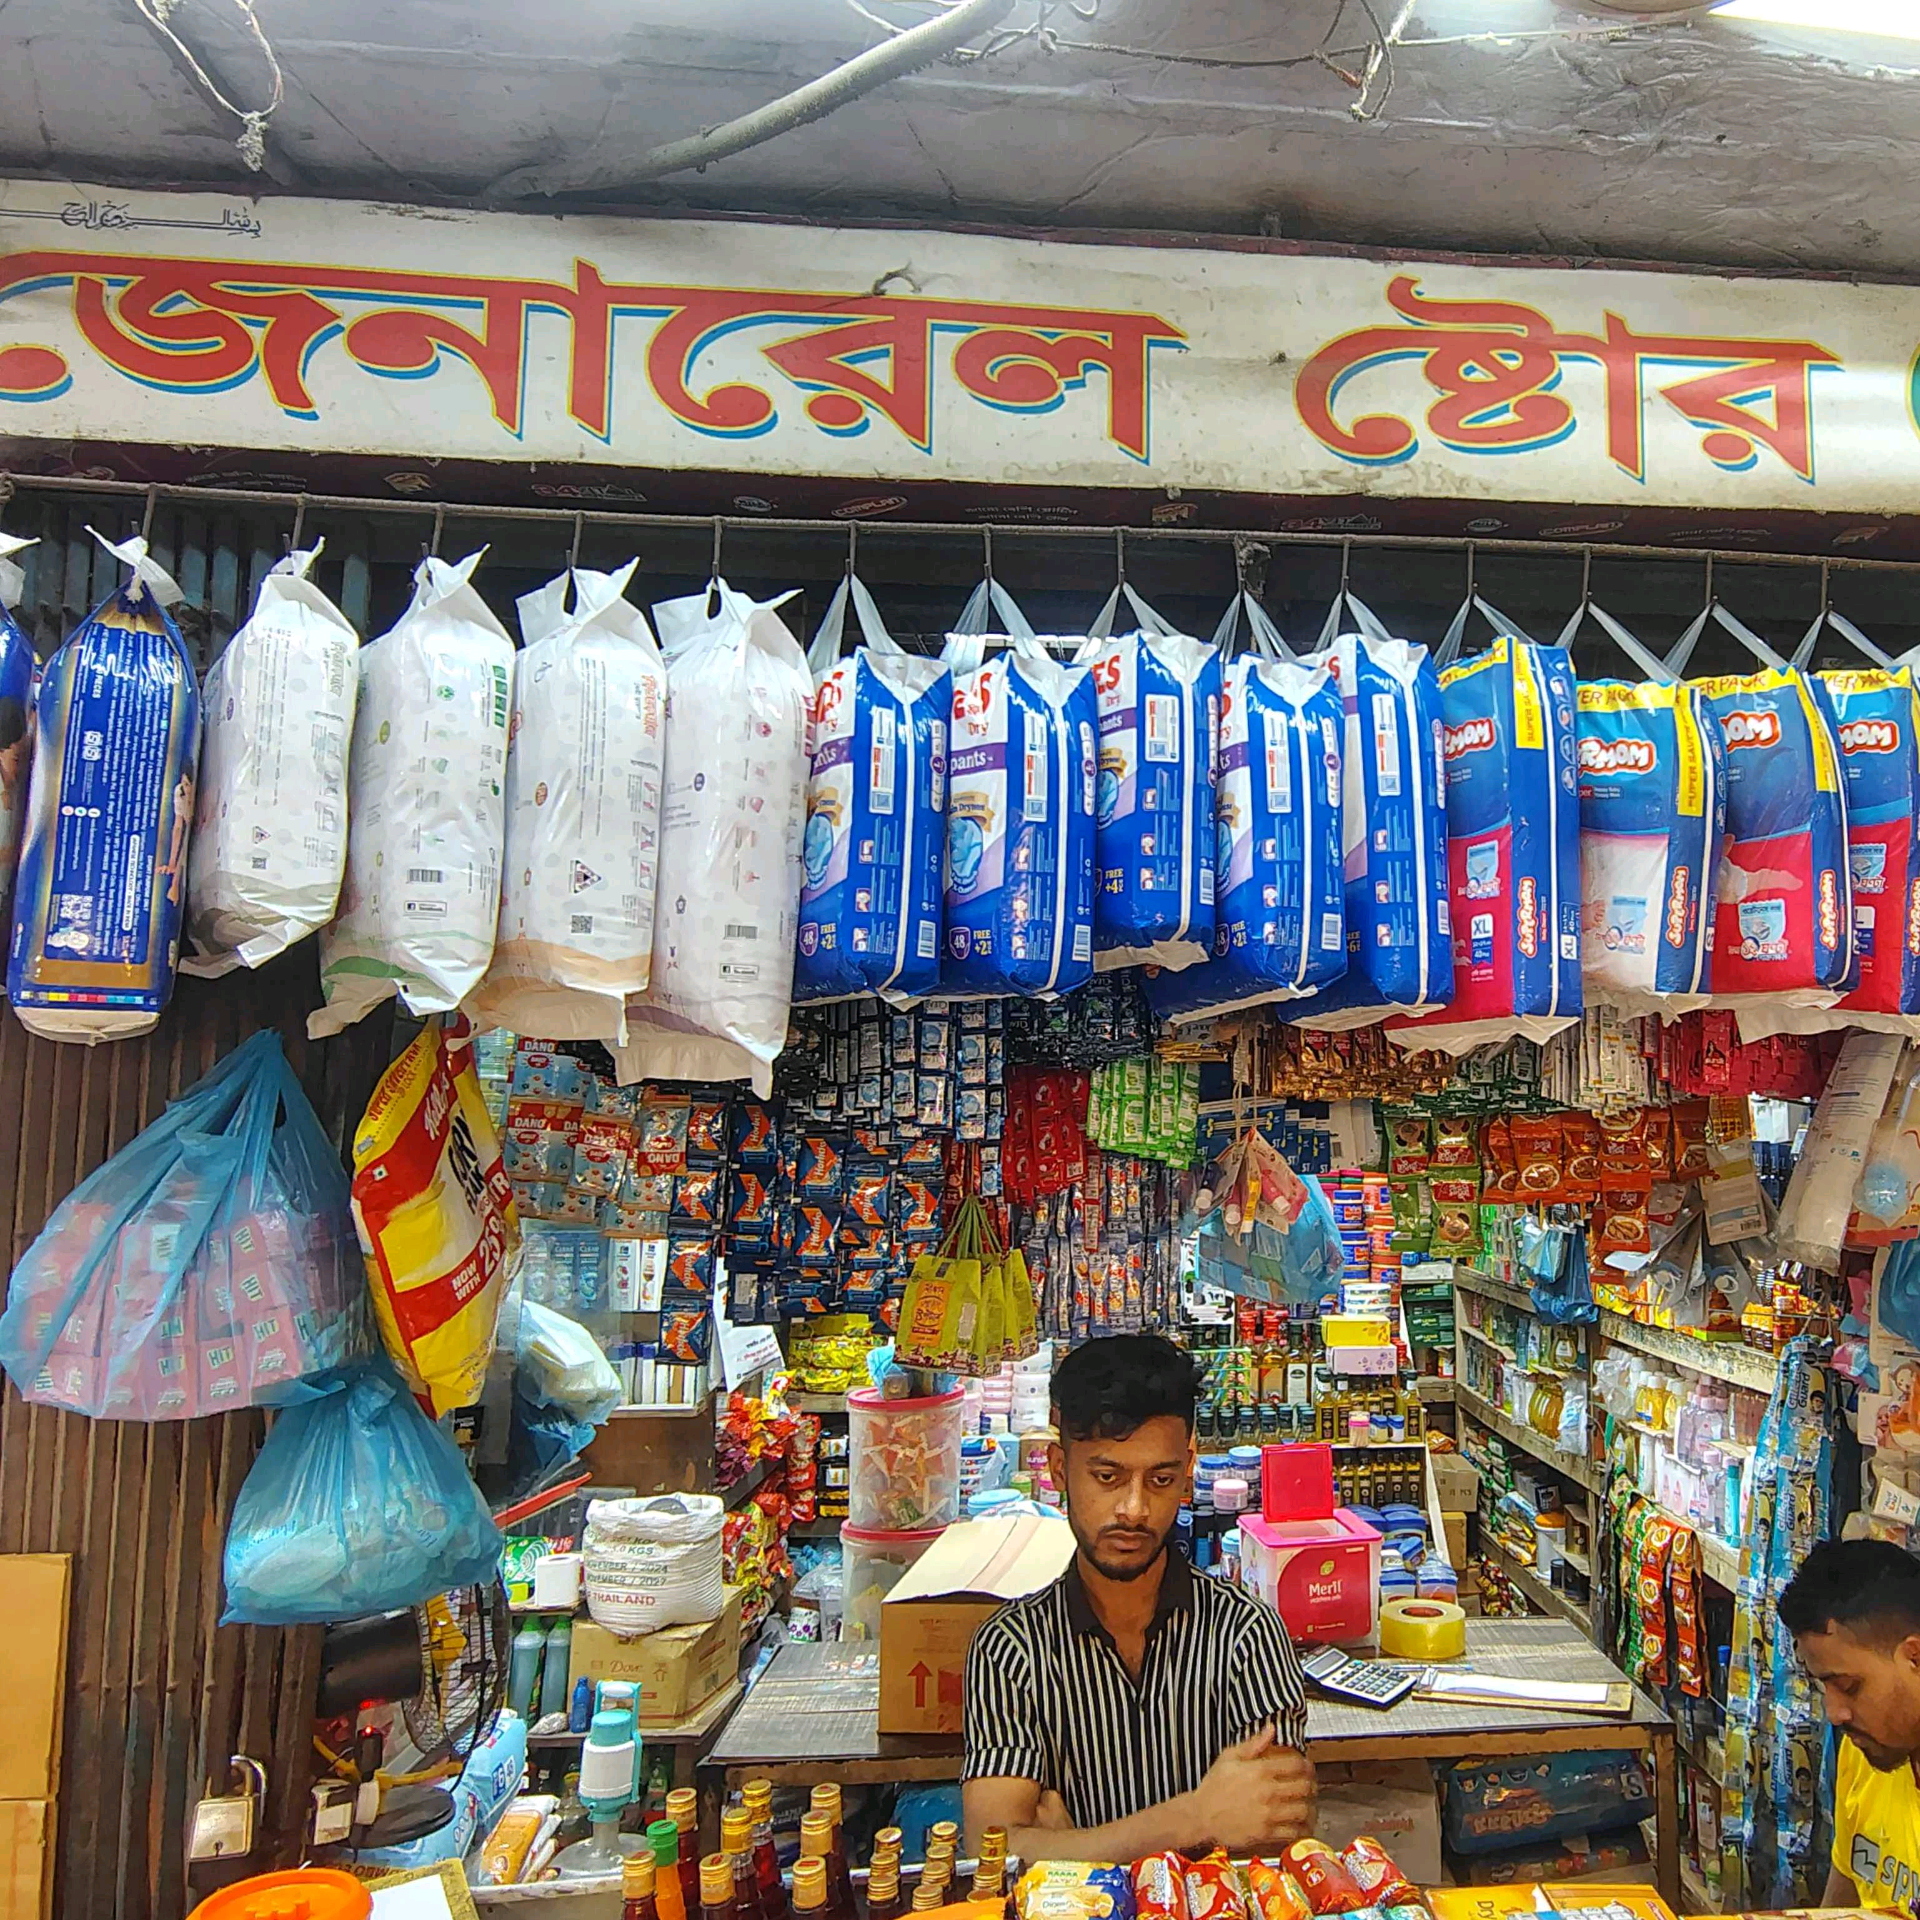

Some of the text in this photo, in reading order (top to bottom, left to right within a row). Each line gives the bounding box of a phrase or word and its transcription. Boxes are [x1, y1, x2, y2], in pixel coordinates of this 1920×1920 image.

[1292, 274, 1846, 487] ষ্টোর
[1104, 867, 1124, 879] FREE
[973, 929, 991, 939] FREE
[1473, 918, 1491, 935] XL
[803, 930, 815, 947] 48
[953, 934, 965, 948] 48
[1564, 938, 1574, 957] XL
[524, 1041, 556, 1053] DANO
[514, 1117, 546, 1129] DANO
[647, 1152, 680, 1163] DANO
[234, 1227, 255, 1251] HIT
[452, 1260, 477, 1291] NOW
[242, 1276, 264, 1300] HIT
[455, 1274, 481, 1301] WITH
[253, 1318, 279, 1340] HIT
[208, 1347, 233, 1368] HIT
[1798, 1372, 1811, 1408] Guard
[1786, 1493, 1796, 1531] Guard
[627, 1546, 654, 1555] KGS
[640, 1564, 668, 1574] 2024
[1308, 1578, 1342, 1597] Meril
[593, 1592, 656, 1606] THAILAND
[609, 1660, 643, 1674] Dove
